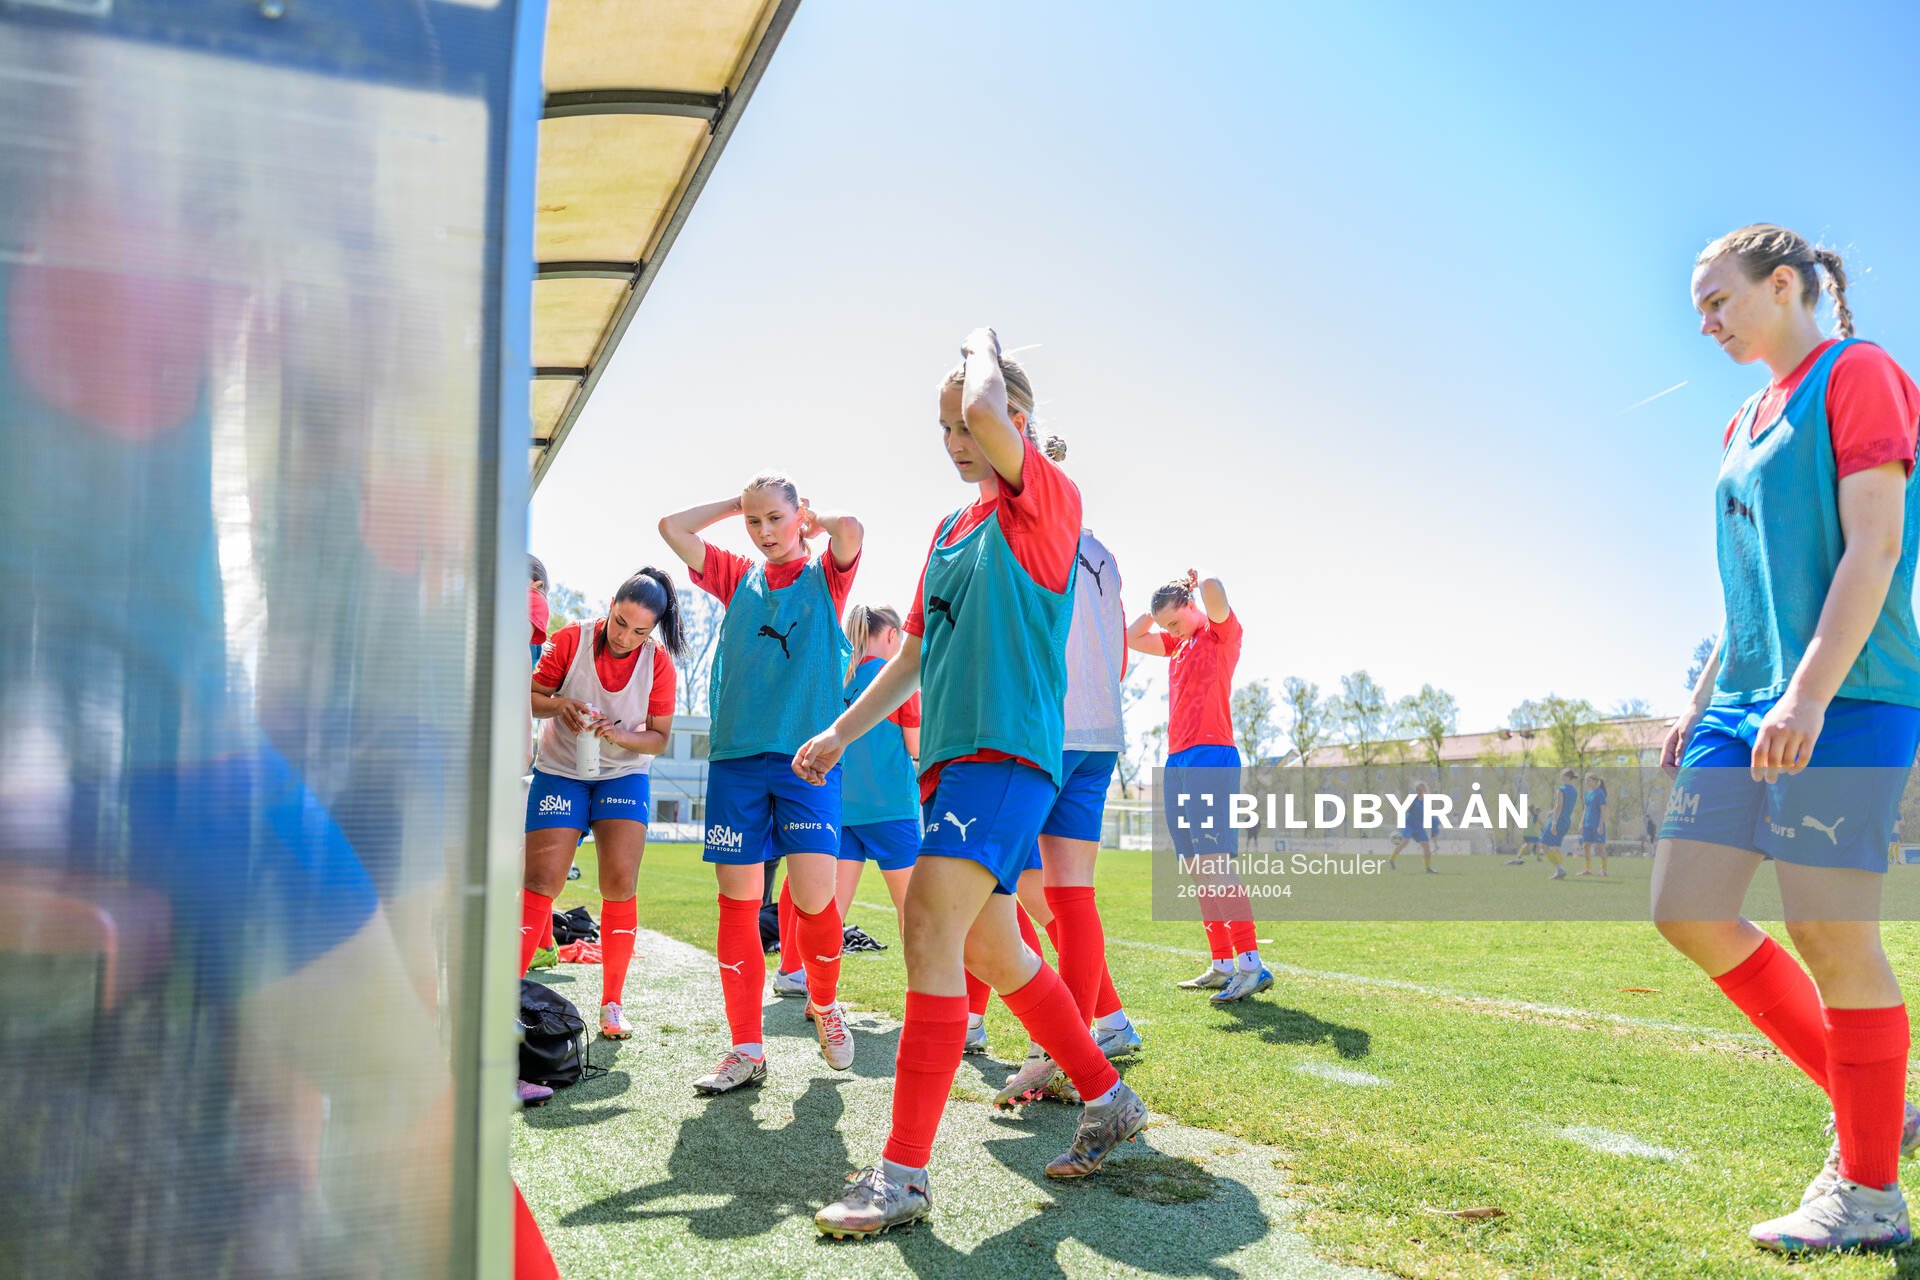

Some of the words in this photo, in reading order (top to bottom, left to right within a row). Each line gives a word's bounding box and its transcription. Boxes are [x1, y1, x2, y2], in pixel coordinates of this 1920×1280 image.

[539, 794, 572, 812] SESAM
[606, 797, 637, 806] Resurs
[1664, 785, 1700, 817] SAM
[789, 822, 822, 830] Resurs
[1770, 822, 1796, 839] surs
[706, 824, 743, 848] SESAM
